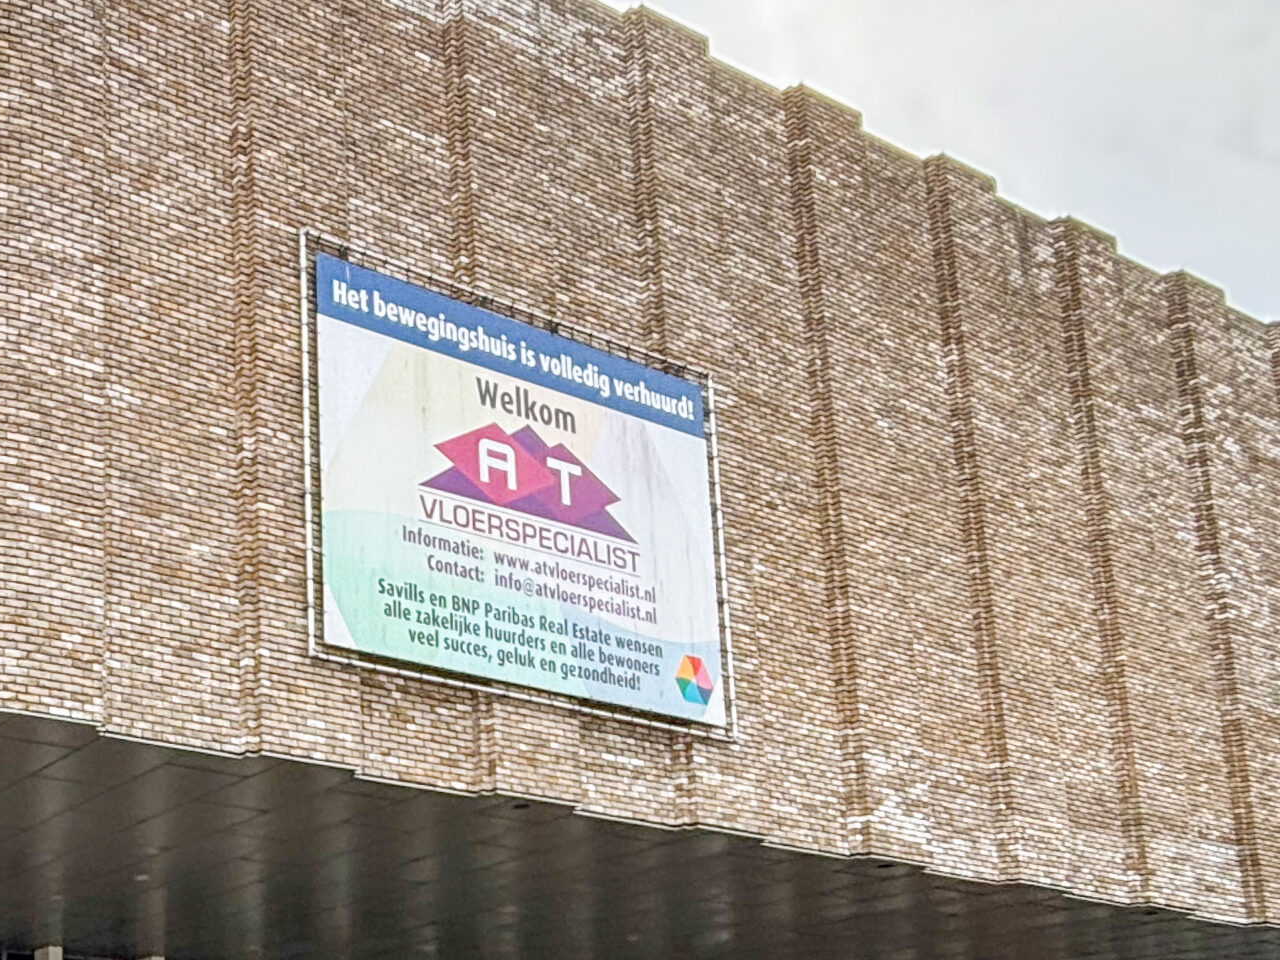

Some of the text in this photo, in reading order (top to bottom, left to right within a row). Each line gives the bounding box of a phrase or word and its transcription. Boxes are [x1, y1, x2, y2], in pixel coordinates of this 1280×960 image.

[333, 279, 696, 421] Het bewegingshuis is volledig verhuurd!
[476, 376, 577, 434] Welkom
[402, 525, 657, 603] Informatie: www.atvloerspecialist.nl
[419, 494, 641, 573] VLOERSPECIALIST
[378, 577, 663, 658] Savills en BNP Paribas Real Estate wensen
[427, 554, 658, 625] Contact: info@atvloerspecialist.nl
[383, 599, 661, 677] alle zakelijke huurders en alle bewoners
[408, 628, 641, 691] veel succes, geluk en gezondheid!
